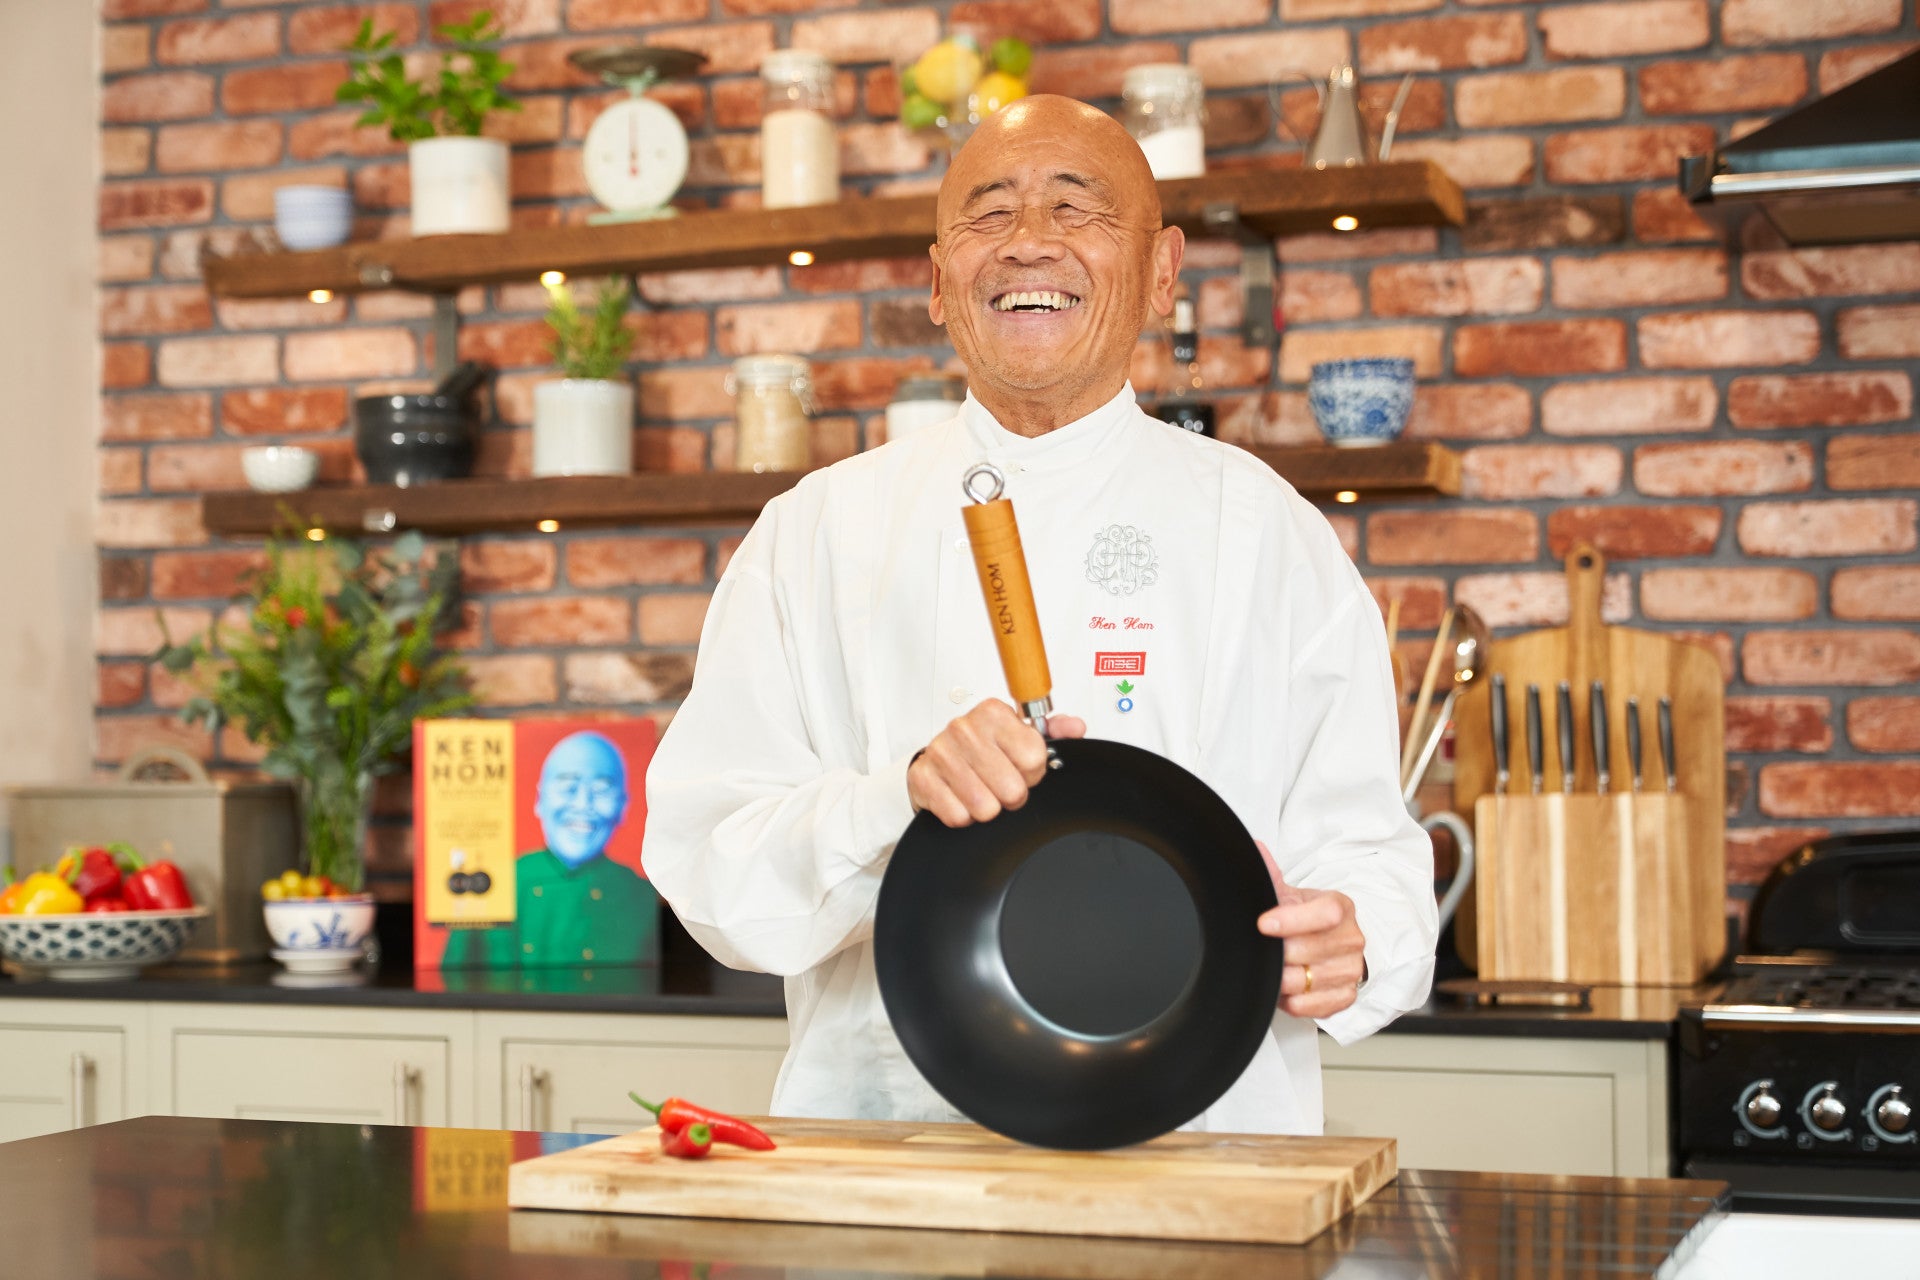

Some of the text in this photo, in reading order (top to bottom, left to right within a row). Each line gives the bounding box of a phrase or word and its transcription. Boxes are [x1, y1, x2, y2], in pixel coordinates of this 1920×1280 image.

[987, 563, 1016, 635] KEN HOM
[1088, 616, 1155, 630] Ken Hom
[436, 737, 503, 757] KEN
[432, 764, 506, 781] HOM
